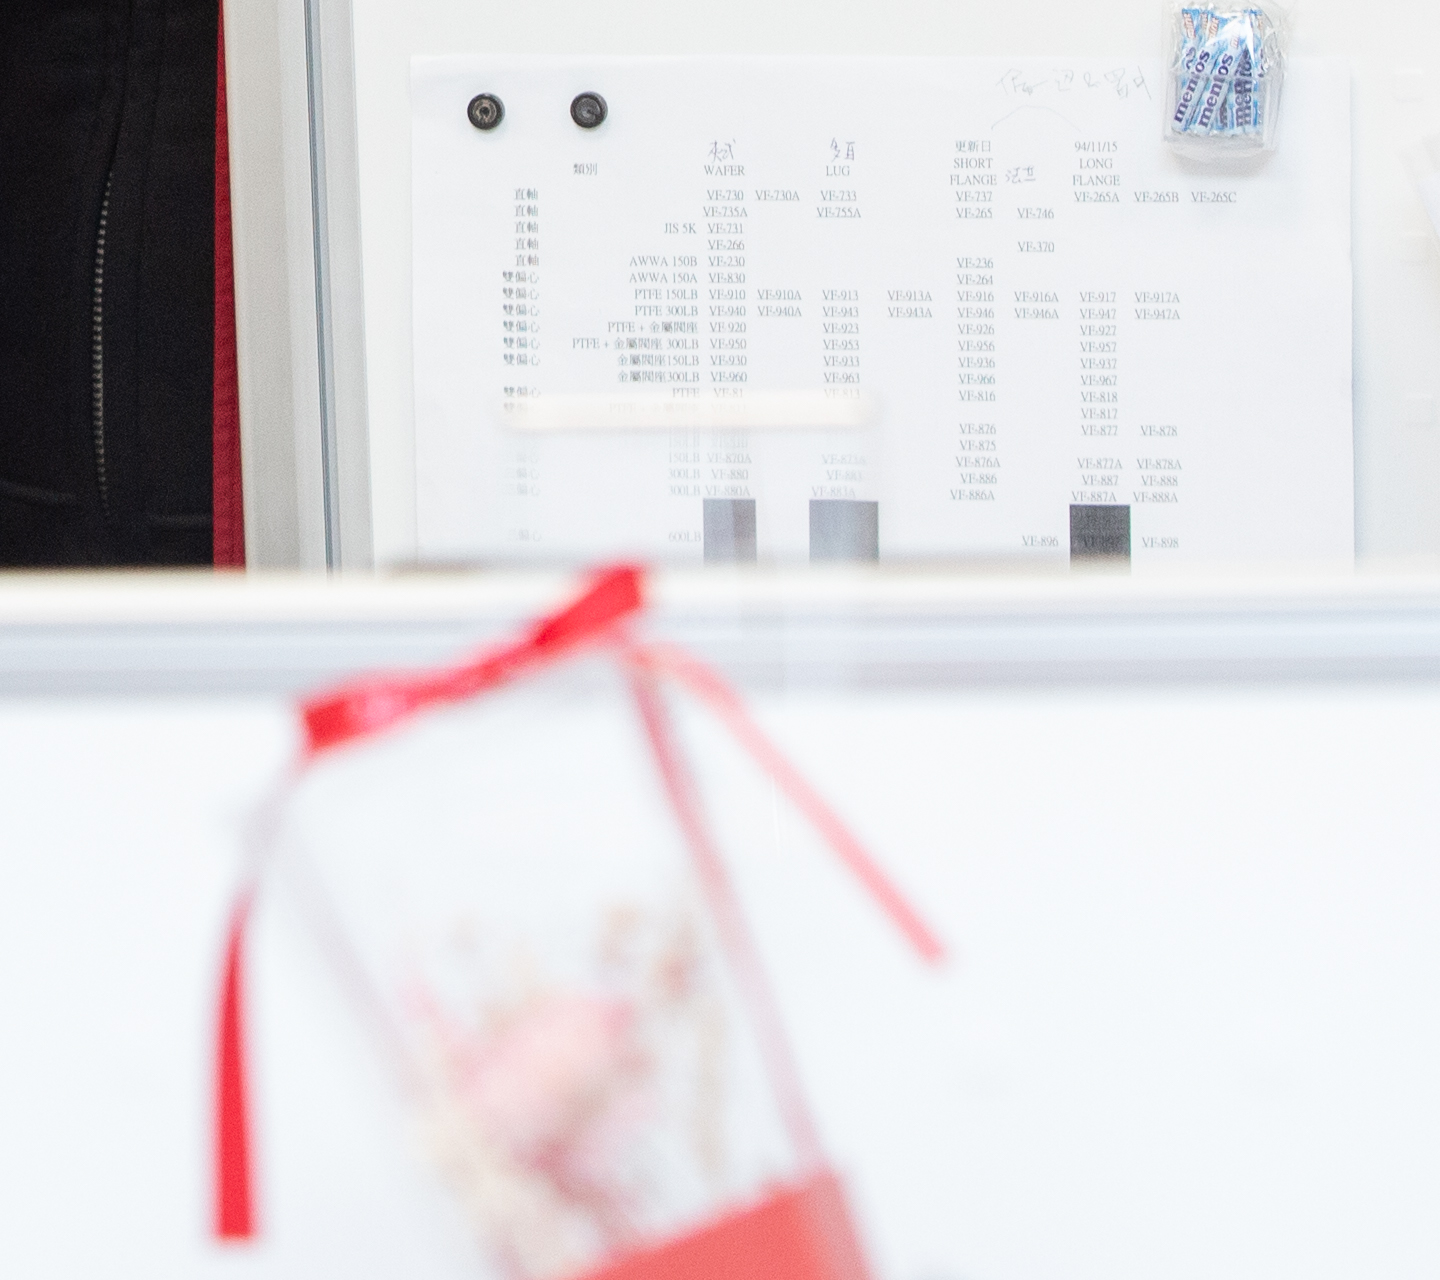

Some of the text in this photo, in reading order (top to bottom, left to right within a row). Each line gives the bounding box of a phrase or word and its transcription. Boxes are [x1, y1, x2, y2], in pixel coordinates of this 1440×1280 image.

[1074, 142, 1118, 153] 94/11/15
[953, 158, 1113, 169] SHORT LONG
[703, 165, 745, 177] WAFER
[826, 166, 850, 177] LUG
[950, 174, 997, 186] FLANGE
[1072, 175, 1121, 186] FLANGE
[664, 223, 679, 234] JIS
[682, 223, 697, 234] 5K
[629, 256, 669, 267] AWWA
[672, 256, 698, 267] 150B
[629, 272, 668, 284] AWWA
[672, 272, 698, 284] 150A
[634, 289, 663, 300] PTFE
[634, 306, 663, 317] PTFE
[666, 306, 699, 317] 300LB
[608, 322, 636, 333] PTFE
[572, 338, 601, 350] PTFE
